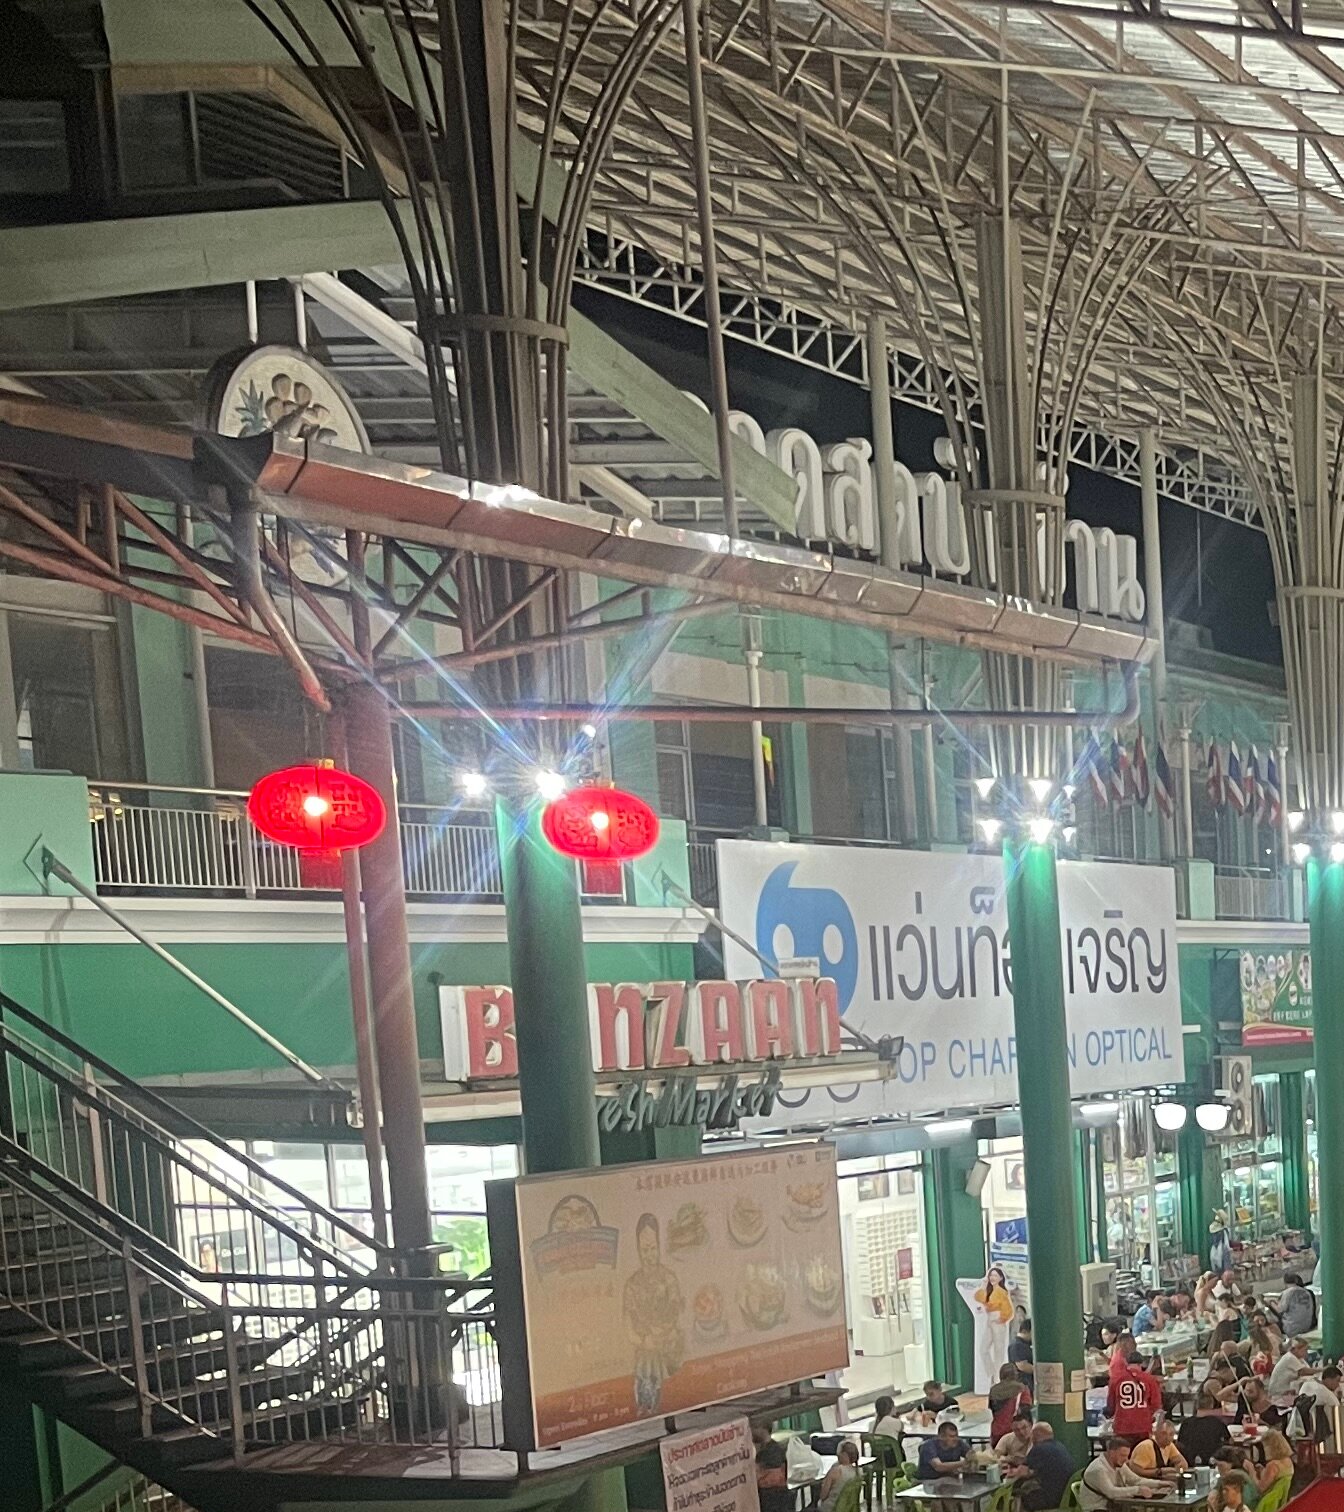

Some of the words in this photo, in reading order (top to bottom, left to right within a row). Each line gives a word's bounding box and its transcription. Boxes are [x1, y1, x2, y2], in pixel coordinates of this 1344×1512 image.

[868, 885, 1169, 1001] แว่นท็เจริญ
[456, 977, 842, 1079] BNZAAN
[898, 1041, 937, 1084] OP
[1085, 1025, 1173, 1067] OPTICAL
[597, 1076, 660, 1133] resh
[662, 1067, 785, 1132] Market
[1119, 1380, 1148, 1410] 91
